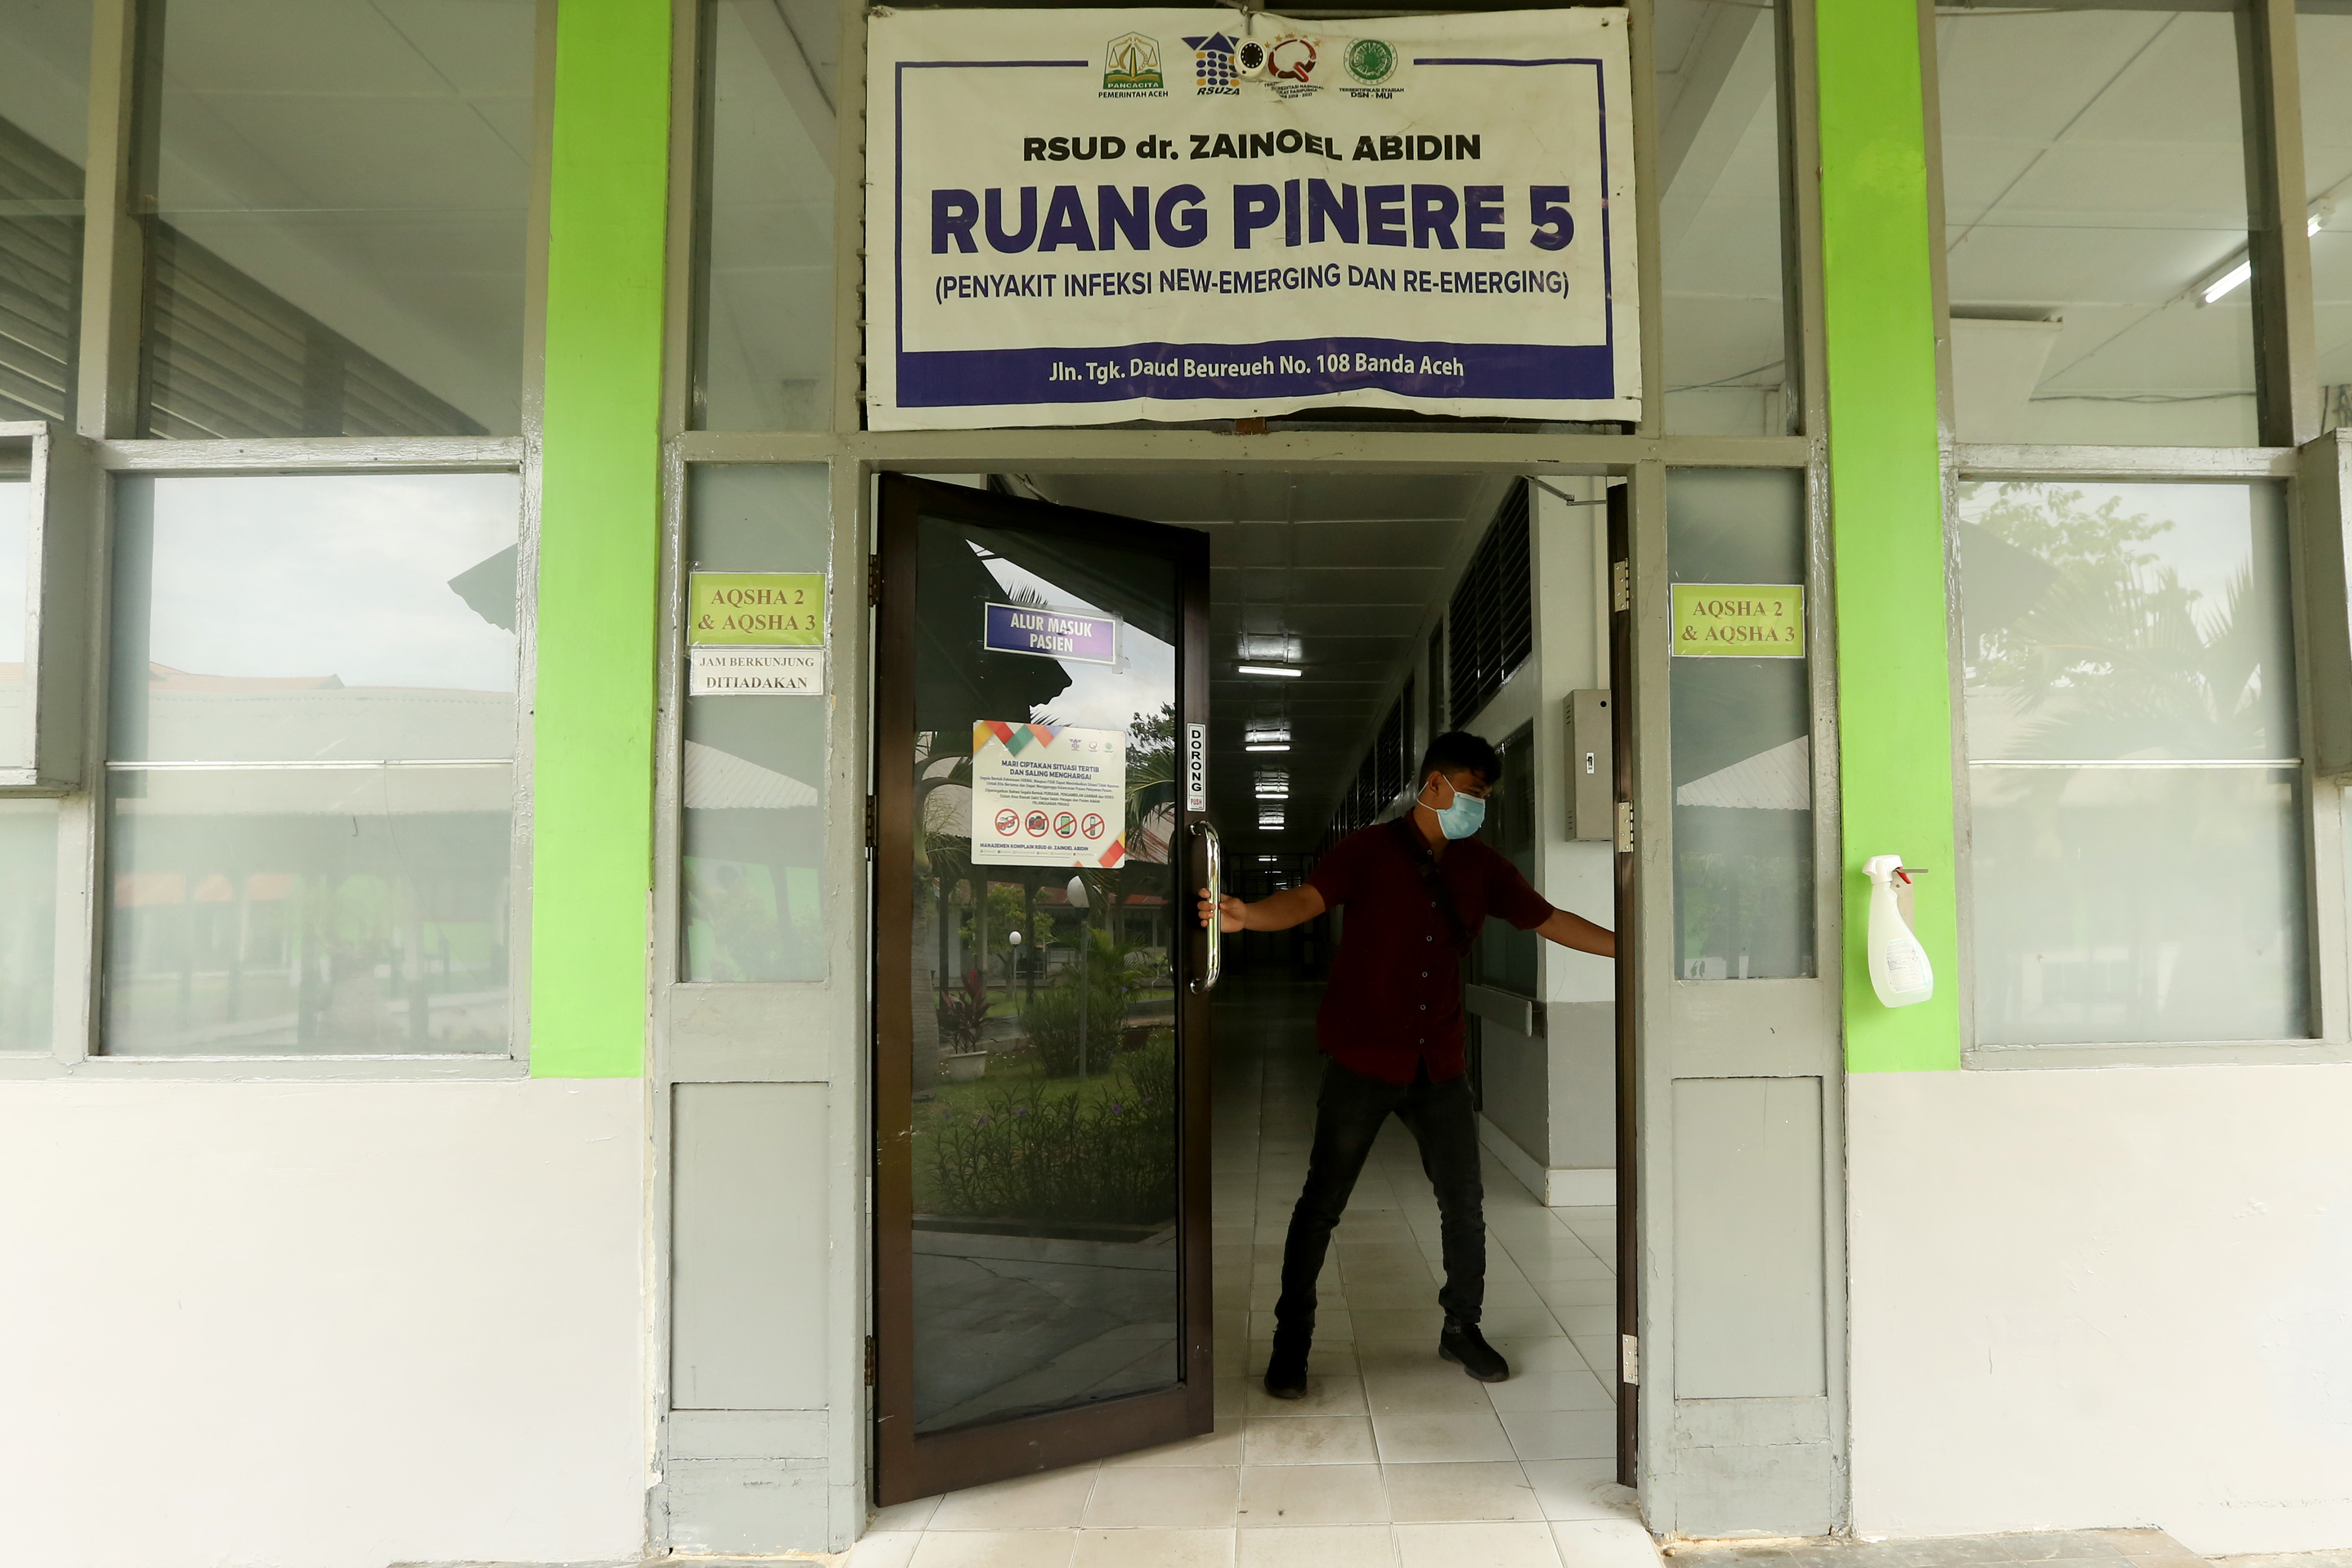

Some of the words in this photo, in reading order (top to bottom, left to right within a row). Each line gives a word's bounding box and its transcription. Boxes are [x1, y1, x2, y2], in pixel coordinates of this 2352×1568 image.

[1197, 87, 1240, 95] RSUZA
[1024, 136, 1126, 162] RSUD
[1135, 135, 1179, 161] dr.
[1190, 129, 1342, 161] ZAINOEL
[1352, 135, 1481, 162] ABIDIN
[931, 184, 1208, 255] RUANG
[1234, 178, 1505, 250] PINERE
[1530, 186, 1575, 251] 5
[936, 274, 1057, 305] (PENYAKIT
[1064, 272, 1152, 297] INFEKSI
[1160, 263, 1341, 294] NEW-EMERGING
[1348, 265, 1396, 292] DAN
[1404, 269, 1569, 300] RE-EMERGING)
[1049, 362, 1083, 381] Jln.
[1085, 360, 1125, 385] Tgk.
[1130, 358, 1178, 377] Daud
[1184, 355, 1274, 378] Beureueh
[1279, 355, 1311, 375] No.
[1317, 353, 1350, 373] 108
[1355, 353, 1415, 374] Banda
[1419, 356, 1464, 377] Aceh
[710, 589, 787, 608] AQSHA
[794, 589, 804, 604] 2
[1693, 600, 1766, 619] AQSHA
[1773, 601, 1783, 616] 2
[698, 614, 715, 630] &
[721, 614, 799, 634] AQSHA
[805, 615, 816, 630] 3
[1010, 613, 1044, 631] ALUR
[1047, 618, 1092, 637] MASUK
[1030, 634, 1073, 652] PASIEN
[1682, 626, 1698, 641] &
[1705, 626, 1779, 644] AQSHA
[1785, 626, 1795, 641] 3
[700, 657, 726, 666] JAM
[730, 657, 814, 666] BERKUNJUNG
[706, 677, 807, 688] DITIADAKAN
[1191, 730, 1202, 791] DORONG
